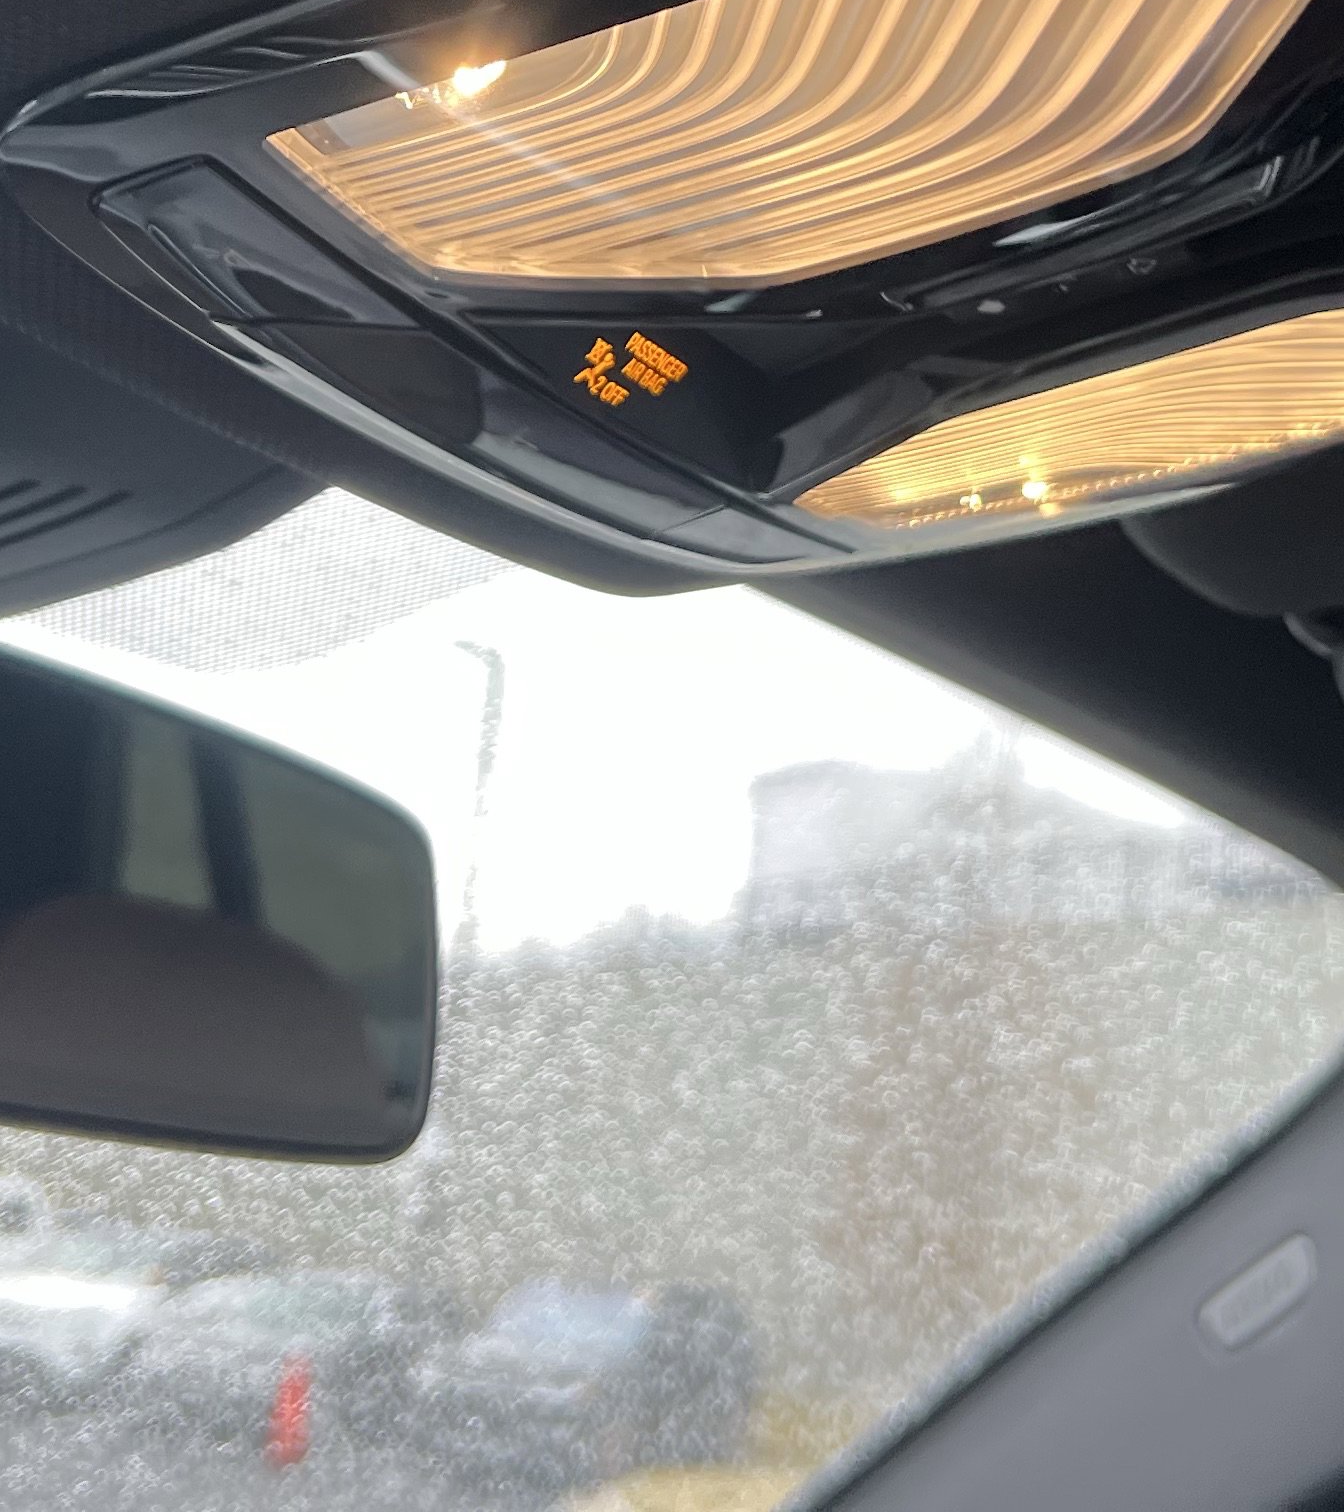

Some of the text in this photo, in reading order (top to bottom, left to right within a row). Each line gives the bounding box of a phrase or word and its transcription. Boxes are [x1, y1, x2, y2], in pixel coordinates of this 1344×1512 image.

[625, 331, 688, 382] PASSENGER
[599, 381, 630, 407] OFF
[638, 368, 668, 396] BAG
